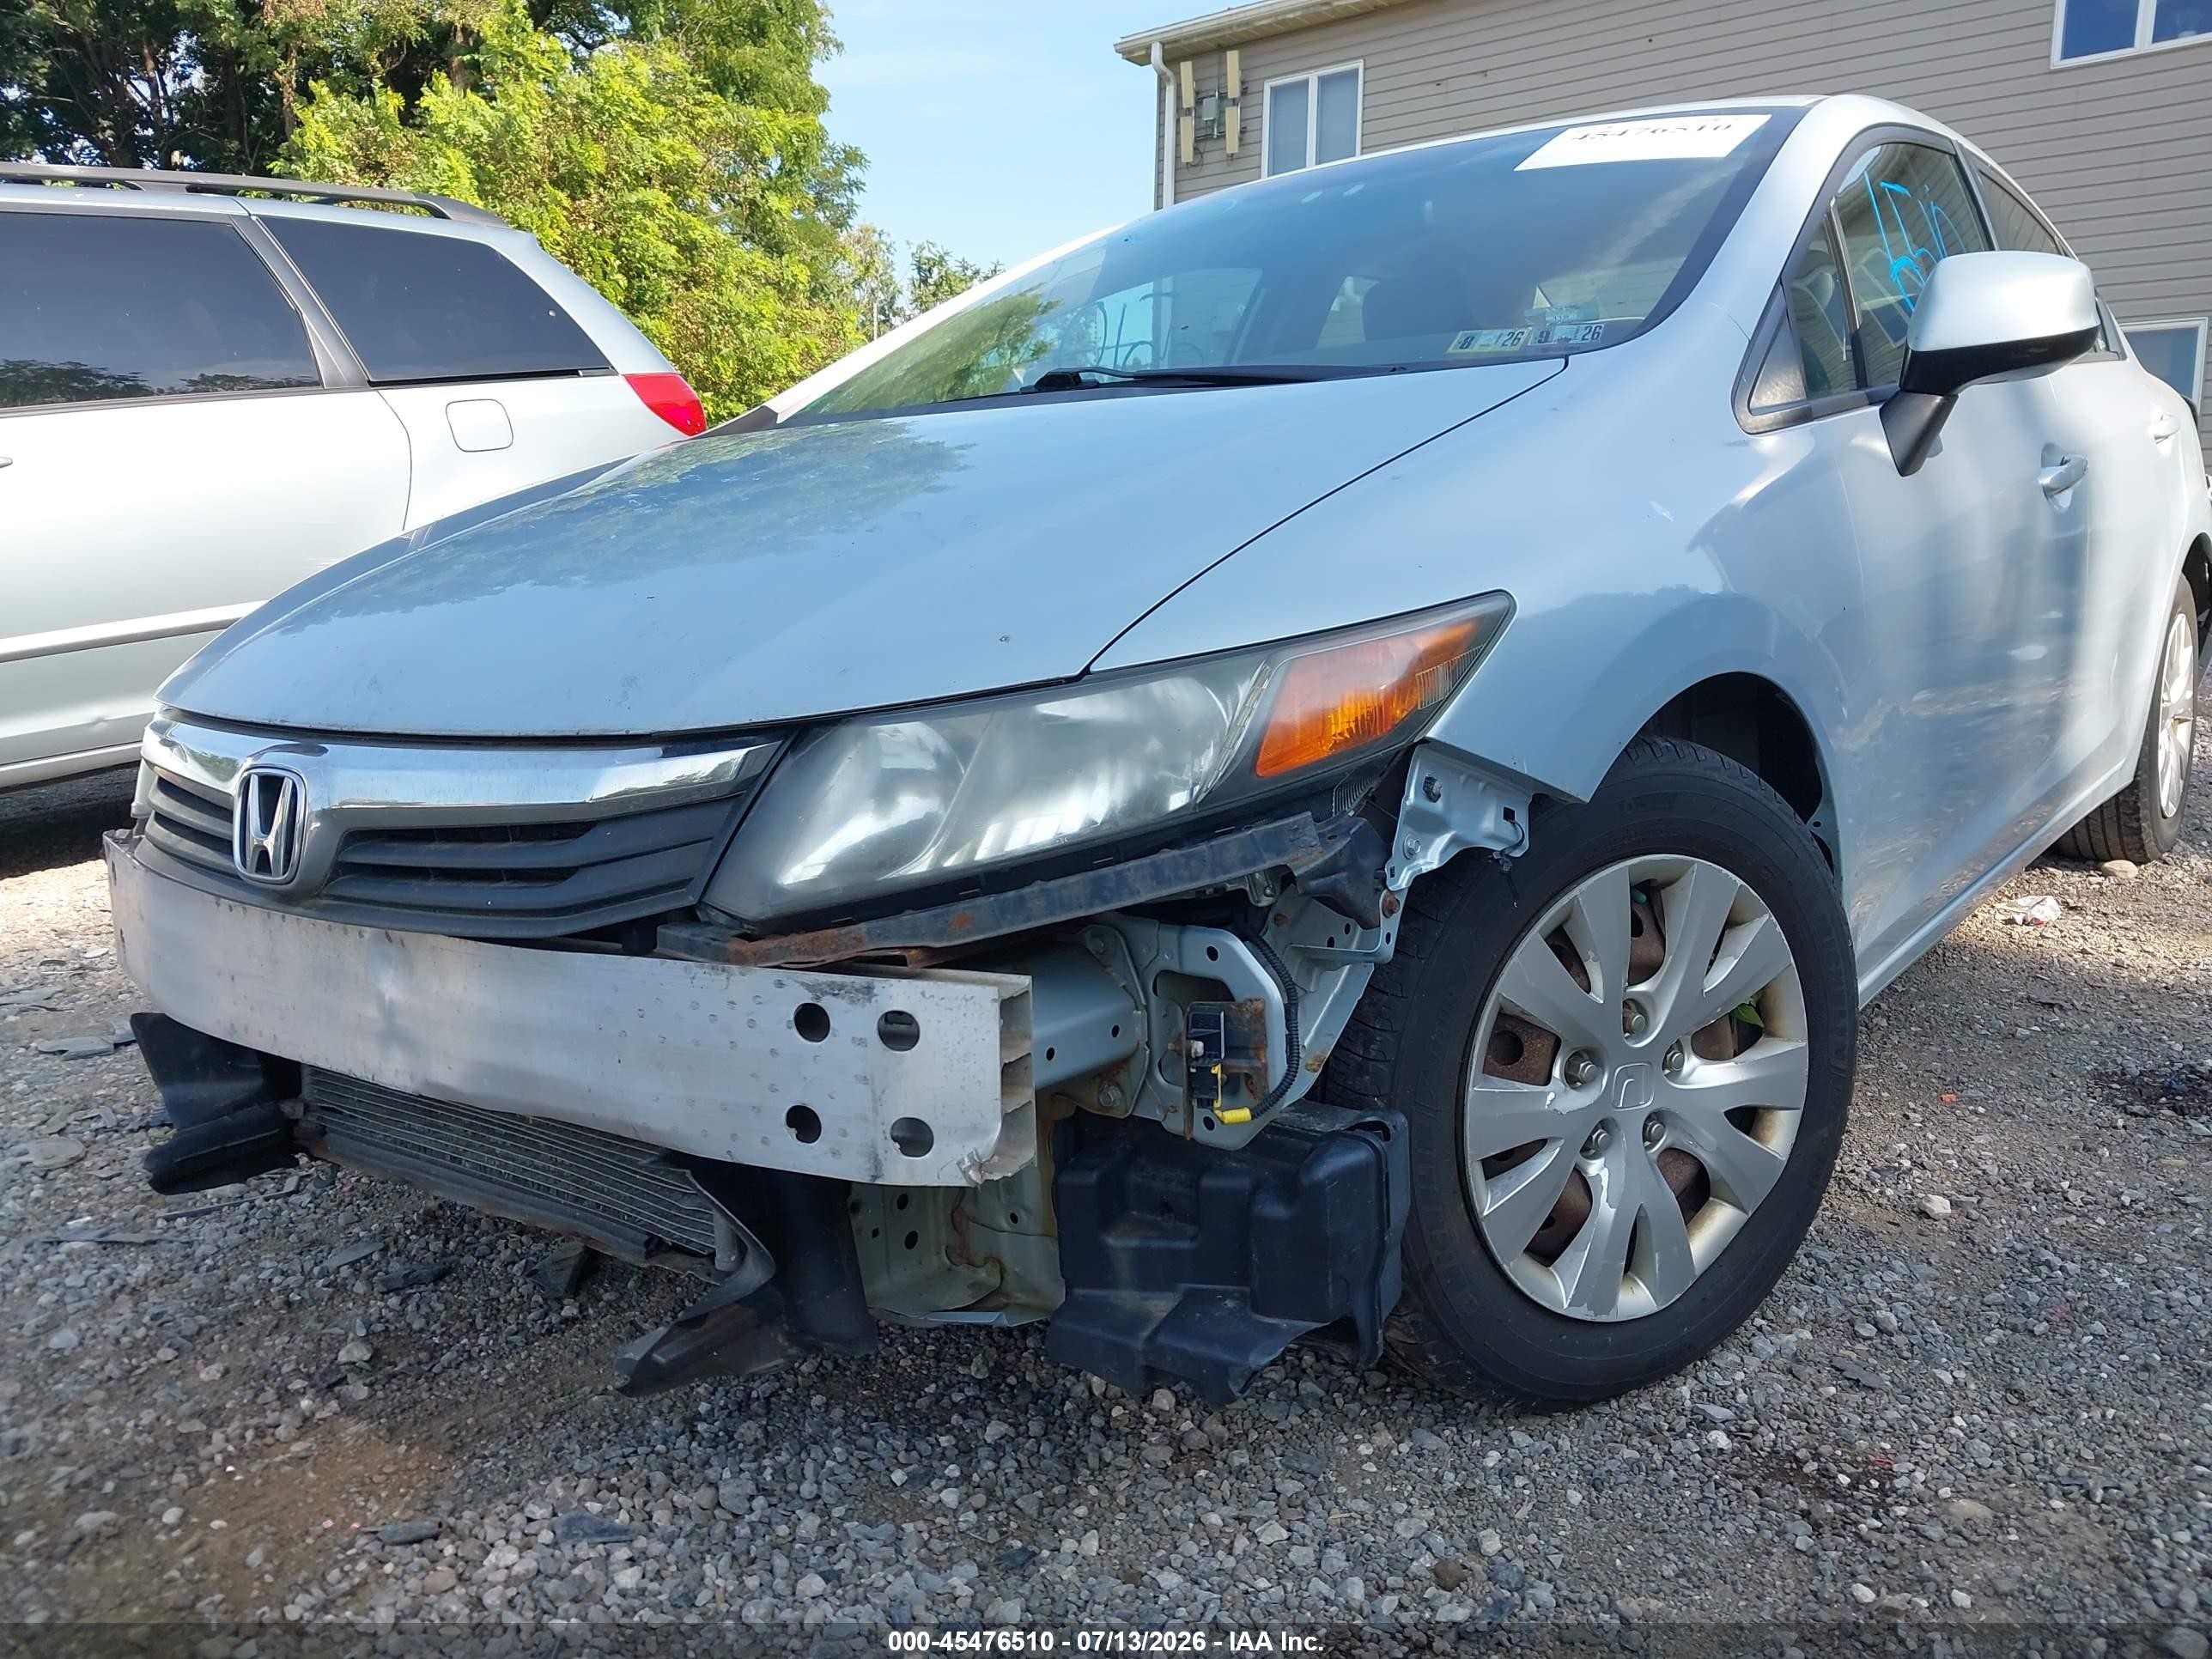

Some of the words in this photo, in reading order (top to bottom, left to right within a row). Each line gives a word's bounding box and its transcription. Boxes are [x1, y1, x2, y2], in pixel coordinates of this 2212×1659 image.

[1501, 331, 1525, 347] 26
[1538, 330, 1551, 343] 9
[1581, 325, 1603, 341] 26
